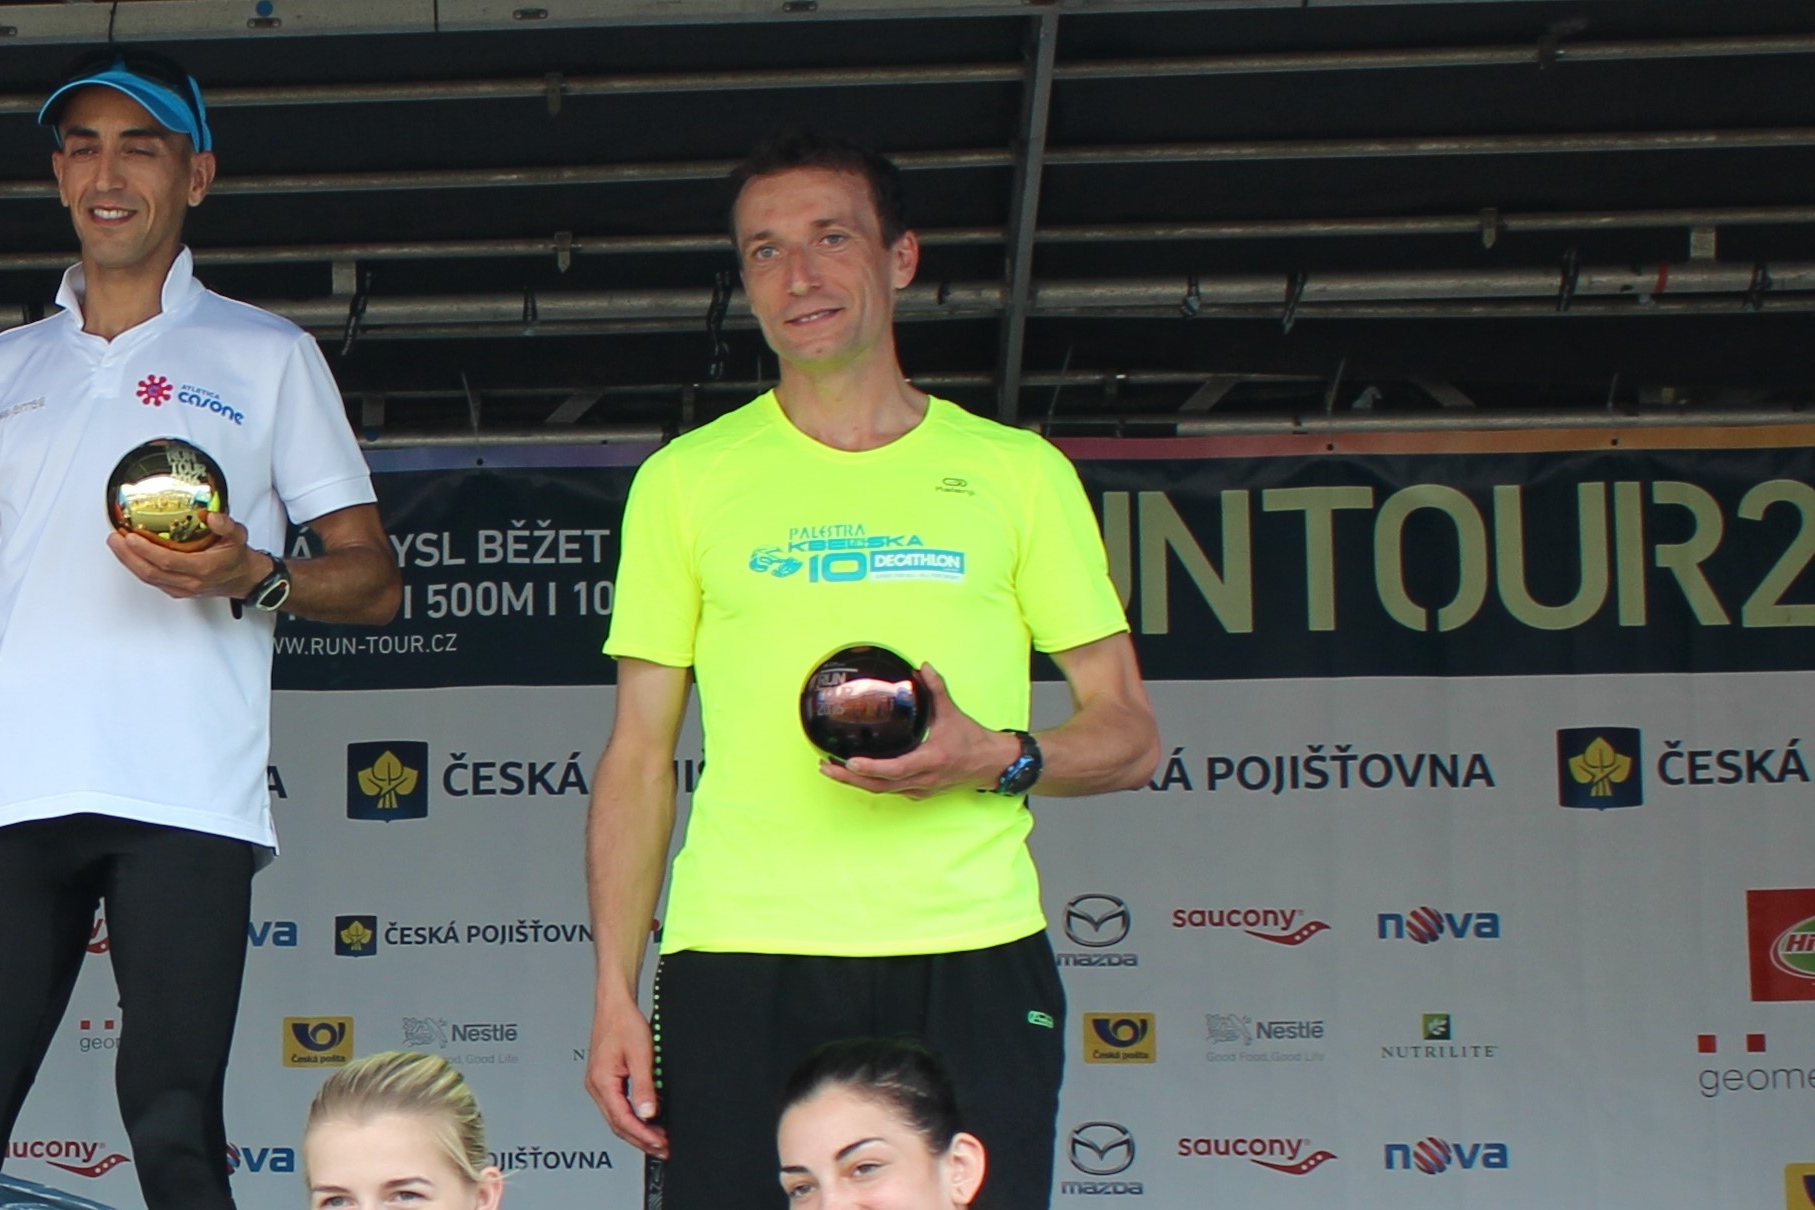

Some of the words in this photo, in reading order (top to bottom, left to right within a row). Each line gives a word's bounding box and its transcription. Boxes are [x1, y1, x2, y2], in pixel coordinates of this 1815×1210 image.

[477, 519, 611, 565] BĚŽET
[789, 523, 866, 540] PALESTRA
[808, 551, 868, 583] 10
[874, 553, 961, 570] DECATHLON
[426, 582, 534, 619] 500M
[442, 749, 589, 798] ČESKÁ
[1206, 743, 1497, 797] POJIŠŤOVNA
[1657, 736, 1813, 787] ČESKÁ
[384, 920, 460, 945] ČESKÁ
[466, 919, 595, 945] POJIŠŤOVN
[1172, 908, 1296, 931] saucony
[1377, 906, 1501, 944] nova
[1056, 953, 1139, 968] mazda
[291, 1053, 318, 1064] Česká
[466, 1054, 495, 1065] Good
[497, 1055, 518, 1065] Life
[1205, 1051, 1236, 1062] Good
[1271, 1051, 1302, 1063] Good
[1381, 1045, 1496, 1059] NUTRILITE
[1177, 1137, 1302, 1161] saucony
[1384, 1136, 1509, 1175] nova
[1061, 1182, 1144, 1195] mazda
